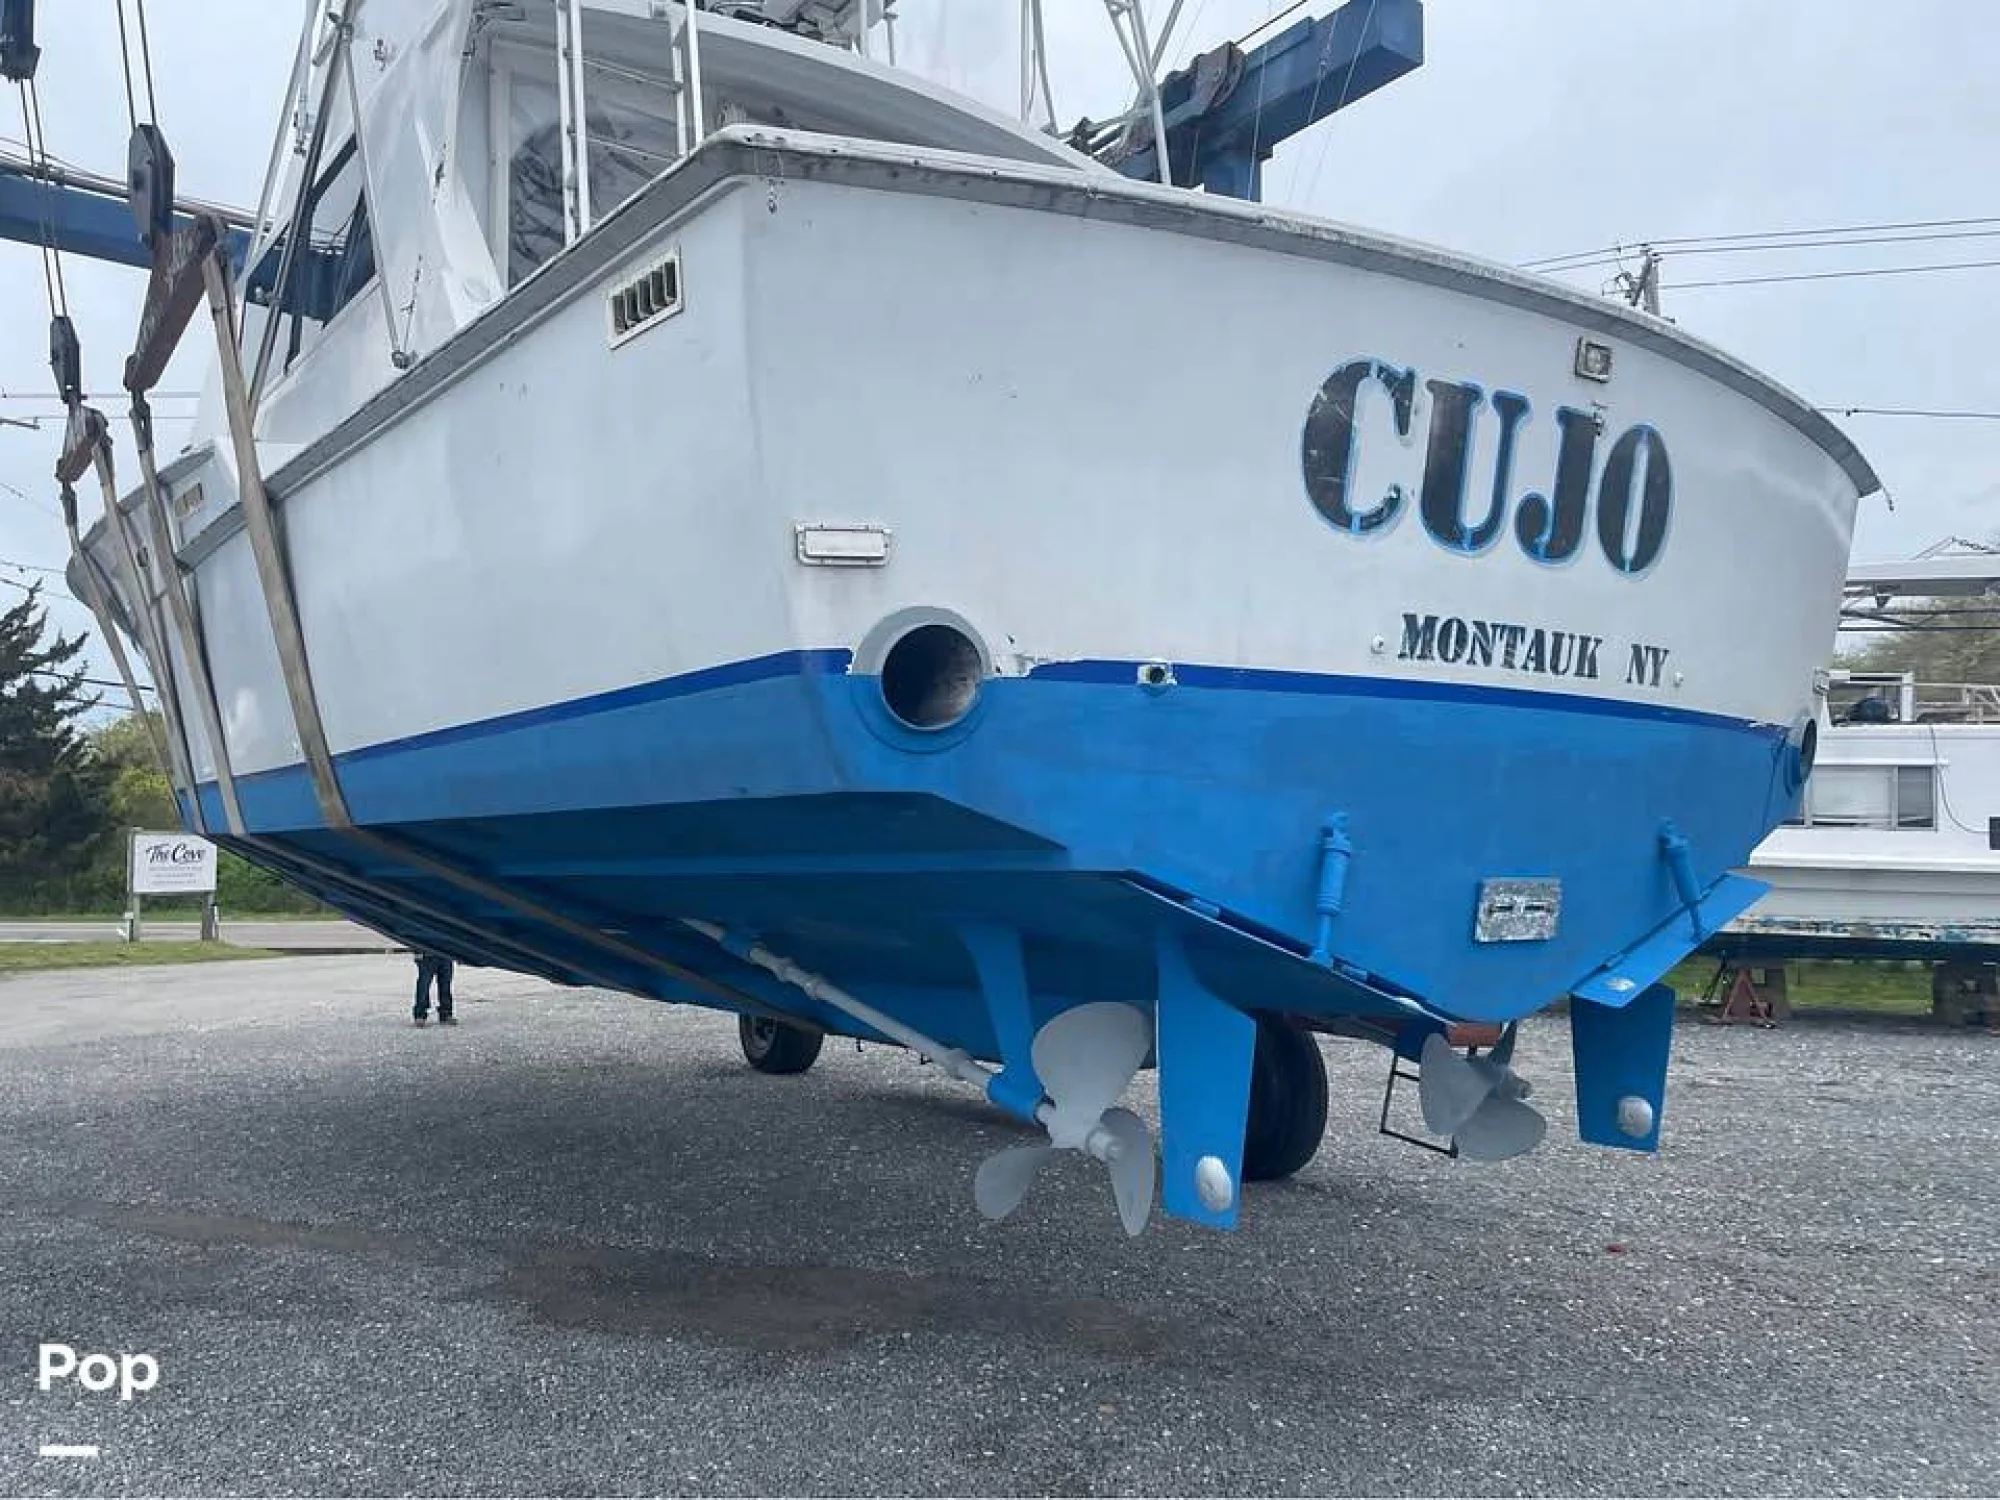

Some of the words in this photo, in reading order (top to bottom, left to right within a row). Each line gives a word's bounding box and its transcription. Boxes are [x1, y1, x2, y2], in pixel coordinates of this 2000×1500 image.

[1302, 358, 1672, 575] CUJO
[1398, 613, 1602, 679] MONTAUK
[1625, 643, 1670, 687] NY
